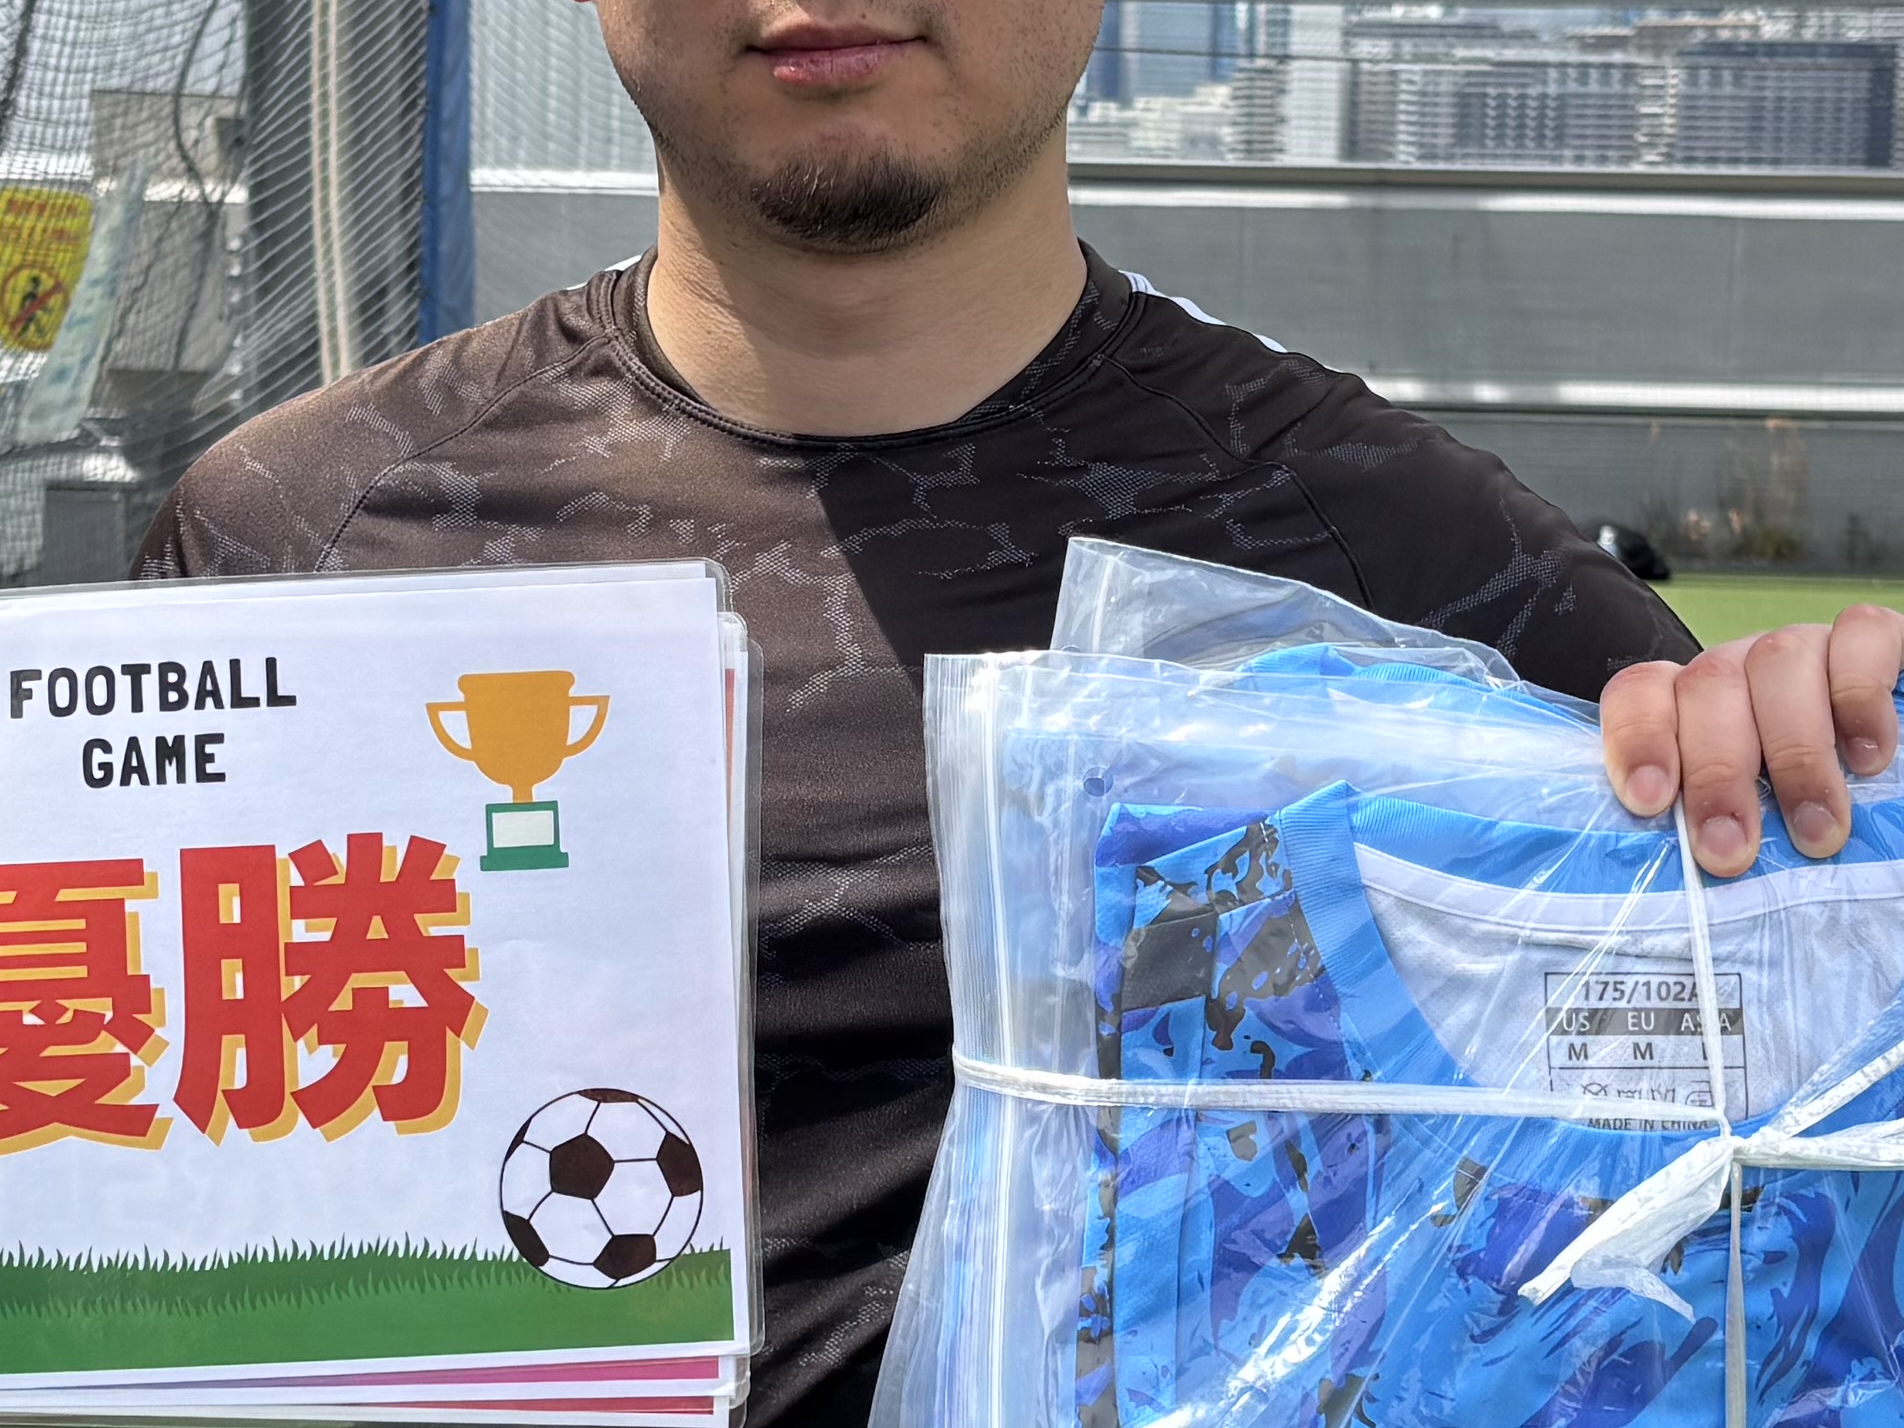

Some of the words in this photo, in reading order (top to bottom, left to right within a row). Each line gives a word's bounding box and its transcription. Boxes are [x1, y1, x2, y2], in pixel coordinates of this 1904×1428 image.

[10, 656, 297, 719] FOOTBALL
[82, 732, 226, 789] GAME
[1562, 1012, 1591, 1032] US
[1627, 1011, 1655, 1031] EU
[1680, 1012, 1732, 1031] AA
[1568, 1042, 1589, 1061] M
[1633, 1042, 1654, 1060] M
